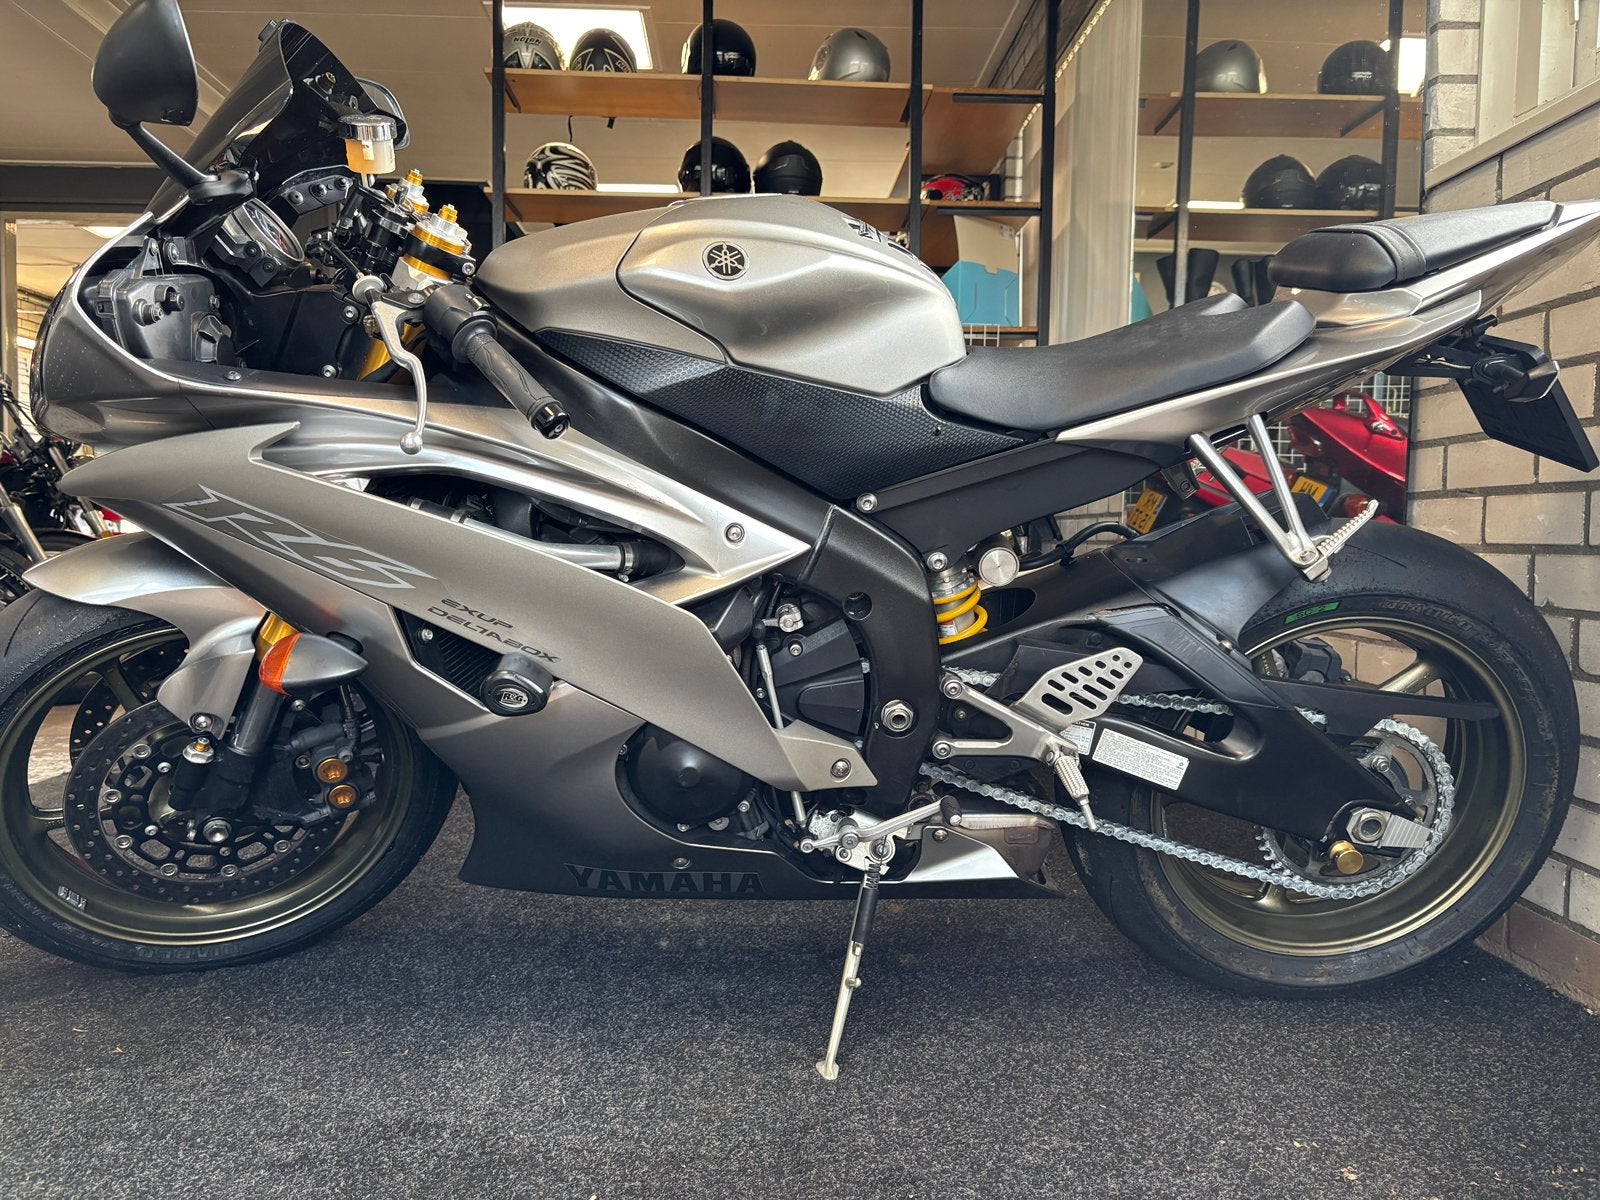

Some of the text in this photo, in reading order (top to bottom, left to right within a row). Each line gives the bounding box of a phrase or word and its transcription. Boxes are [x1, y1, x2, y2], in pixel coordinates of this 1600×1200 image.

[513, 36, 542, 45] NOLAN
[441, 598, 513, 629] EXUP
[427, 606, 559, 663] DELTABOX
[565, 864, 764, 893] YAMAHA
